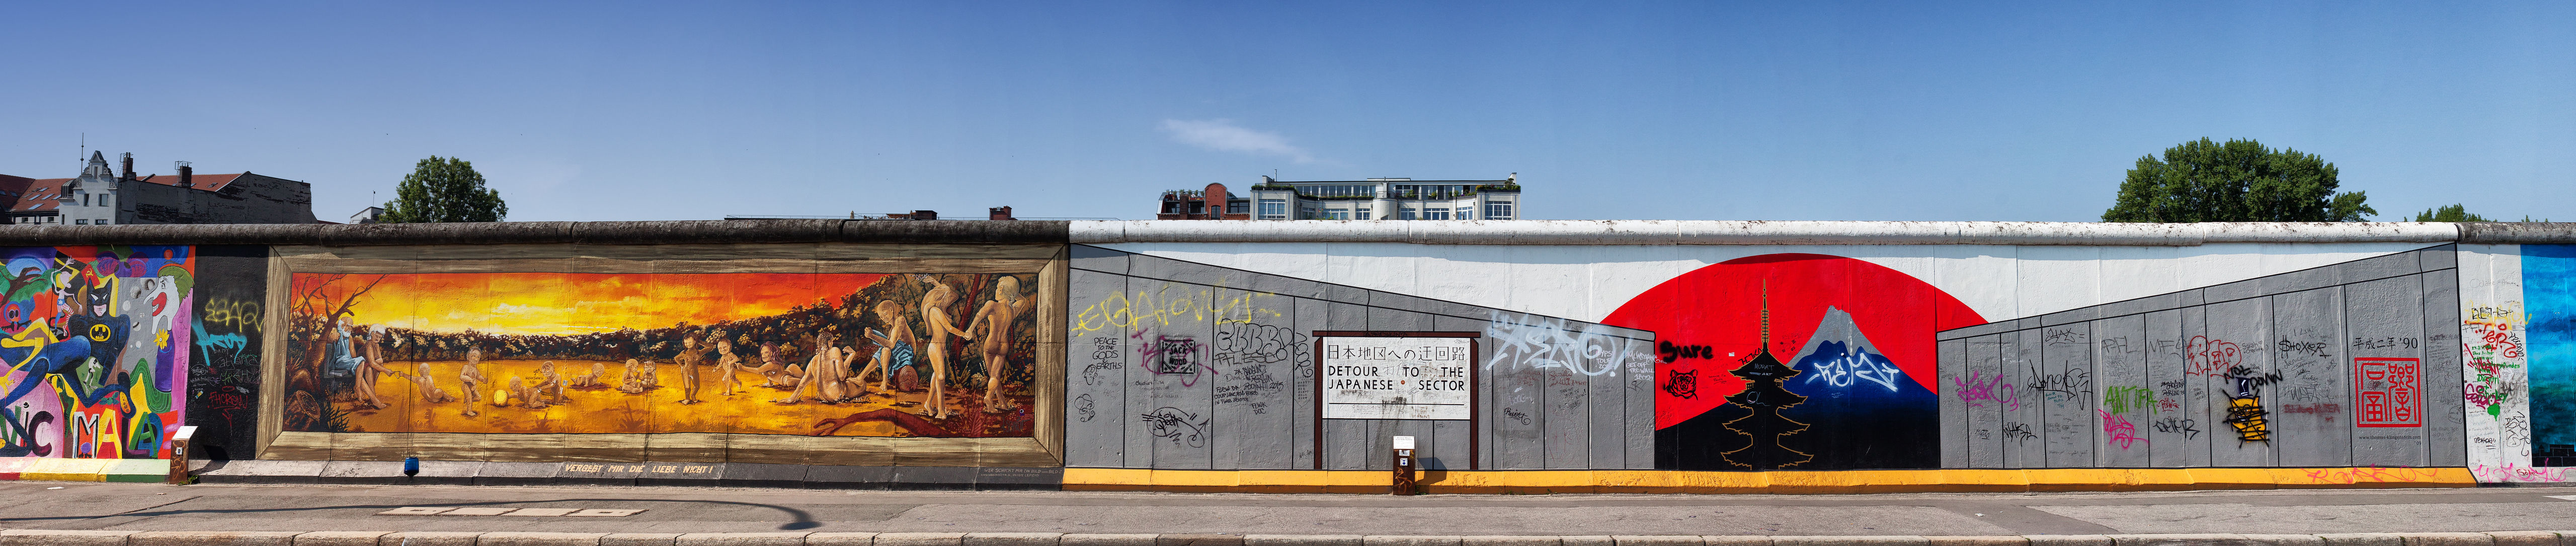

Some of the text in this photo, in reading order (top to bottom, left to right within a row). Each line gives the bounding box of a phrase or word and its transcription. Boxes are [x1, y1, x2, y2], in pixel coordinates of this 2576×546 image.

[1094, 337, 1118, 346] PEACE
[2242, 342, 2258, 350] Sarah
[2354, 337, 2396, 351] 平成二年
[1092, 351, 1118, 359] GODS
[1329, 345, 1465, 361] 日本地区への迂回路
[1169, 358, 1187, 366] WOOD
[1329, 366, 1463, 377] DETOUR TO THE
[2224, 365, 2252, 384] NOT
[1329, 379, 1465, 391] JAPANESE SECTOR
[2249, 369, 2283, 390] DOWN
[2104, 385, 2158, 415] ANTIFA
[652, 465, 678, 474] LIEBE
